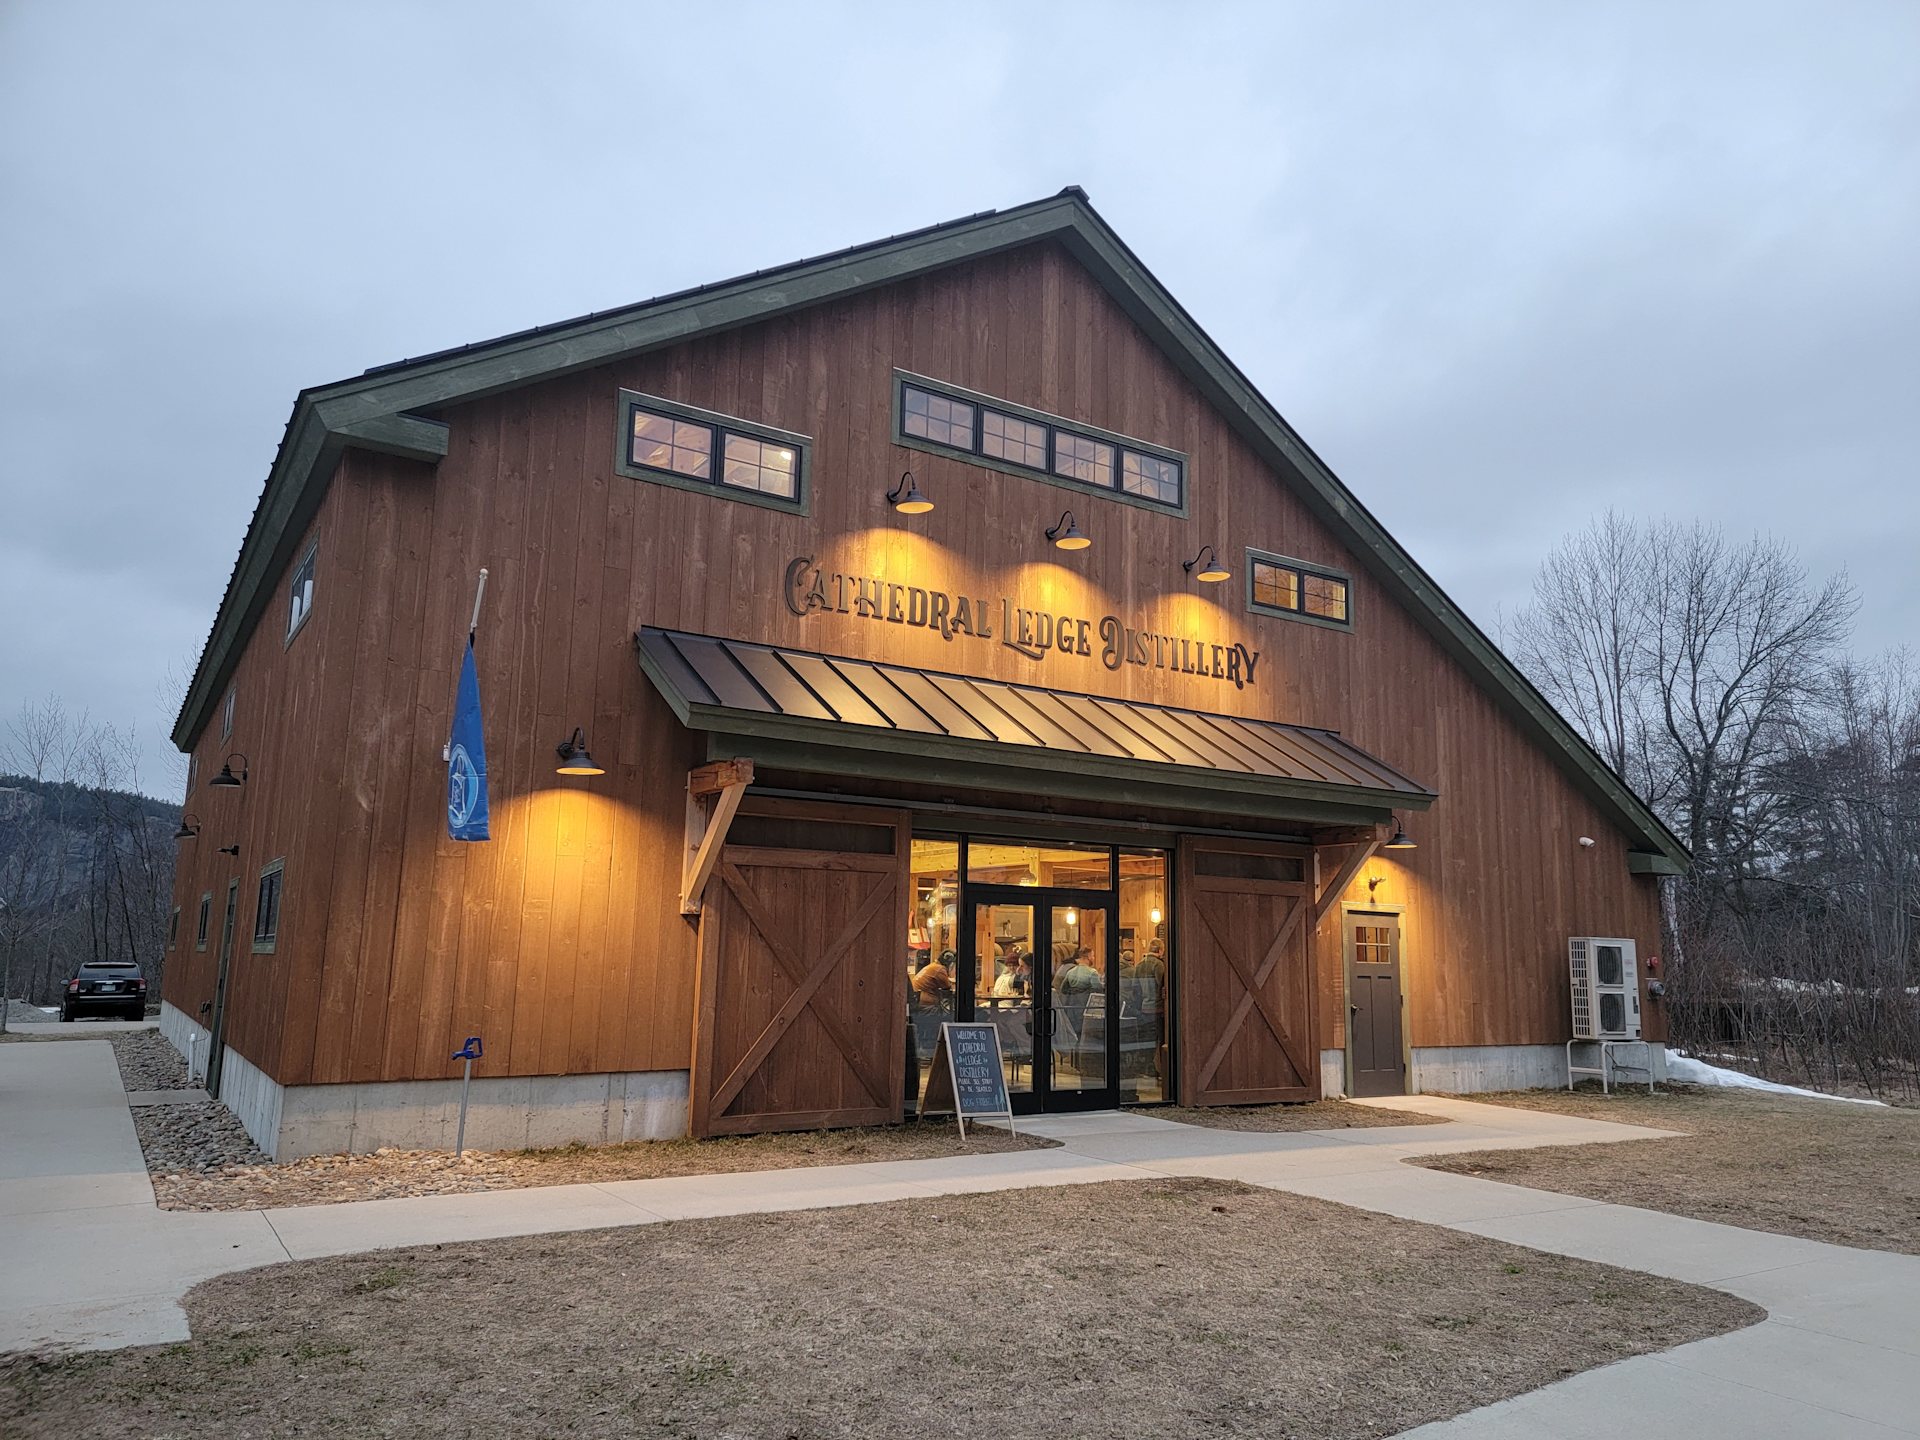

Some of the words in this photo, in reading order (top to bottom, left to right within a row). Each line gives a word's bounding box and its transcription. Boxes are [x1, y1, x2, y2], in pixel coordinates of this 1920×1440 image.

[785, 555, 992, 641] CATHEDRAL
[1002, 599, 1091, 661] LEDGE
[1099, 615, 1259, 690] DISTILLERY
[956, 1031, 977, 1040] WELCOME
[958, 1042, 987, 1054] CATHEDRAL
[965, 1055, 982, 1065] LEDGE
[960, 1066, 989, 1079] DISTILLERY
